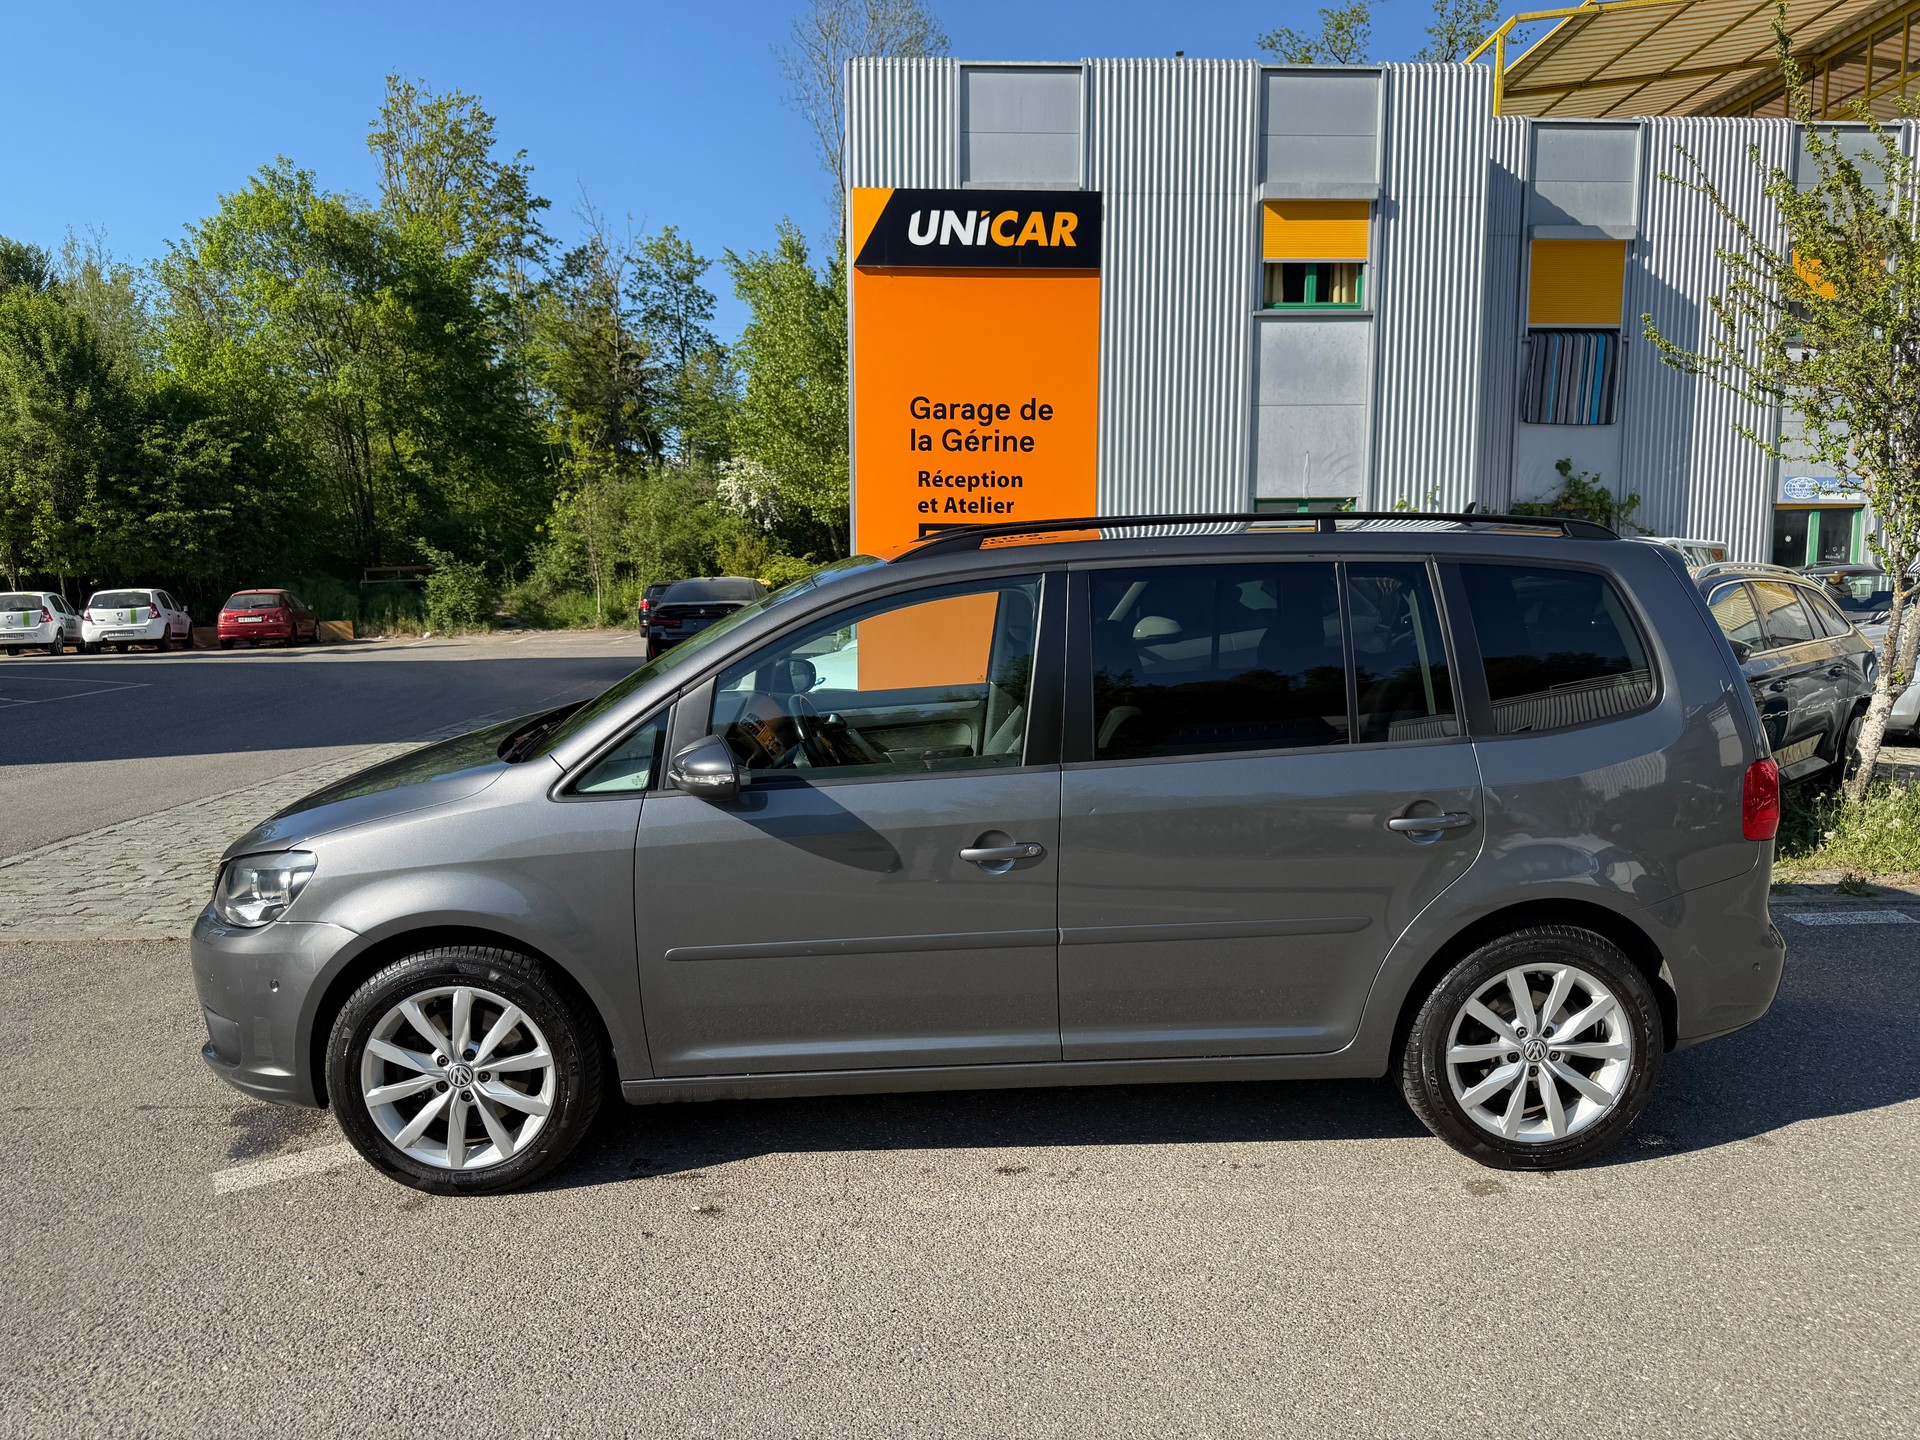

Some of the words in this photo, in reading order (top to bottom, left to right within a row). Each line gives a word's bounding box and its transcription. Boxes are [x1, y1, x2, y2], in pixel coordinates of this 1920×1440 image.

[910, 396, 1011, 427] Garage
[1020, 397, 1054, 421] de
[910, 428, 932, 451] la
[941, 428, 1035, 453] Gérine
[918, 469, 1023, 492] Réception
[917, 497, 939, 513] et
[943, 496, 1015, 513] Atelier
